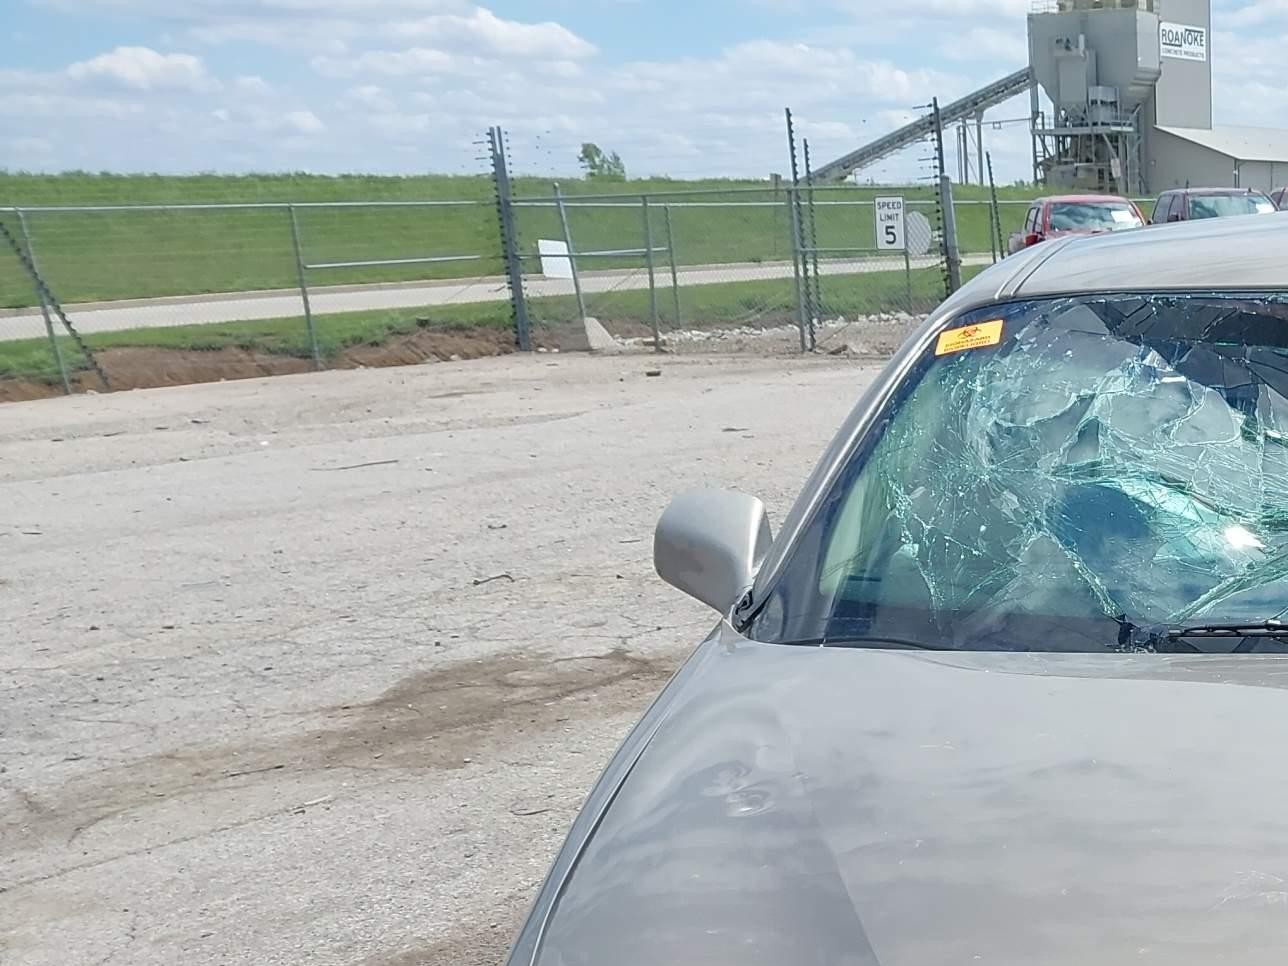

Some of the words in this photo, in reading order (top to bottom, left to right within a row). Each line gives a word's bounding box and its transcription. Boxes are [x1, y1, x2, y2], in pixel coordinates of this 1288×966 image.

[1161, 28, 1204, 47] ROANOKE
[877, 201, 902, 210] SPEED
[880, 213, 899, 222] LIMIT
[885, 225, 897, 245] 5
